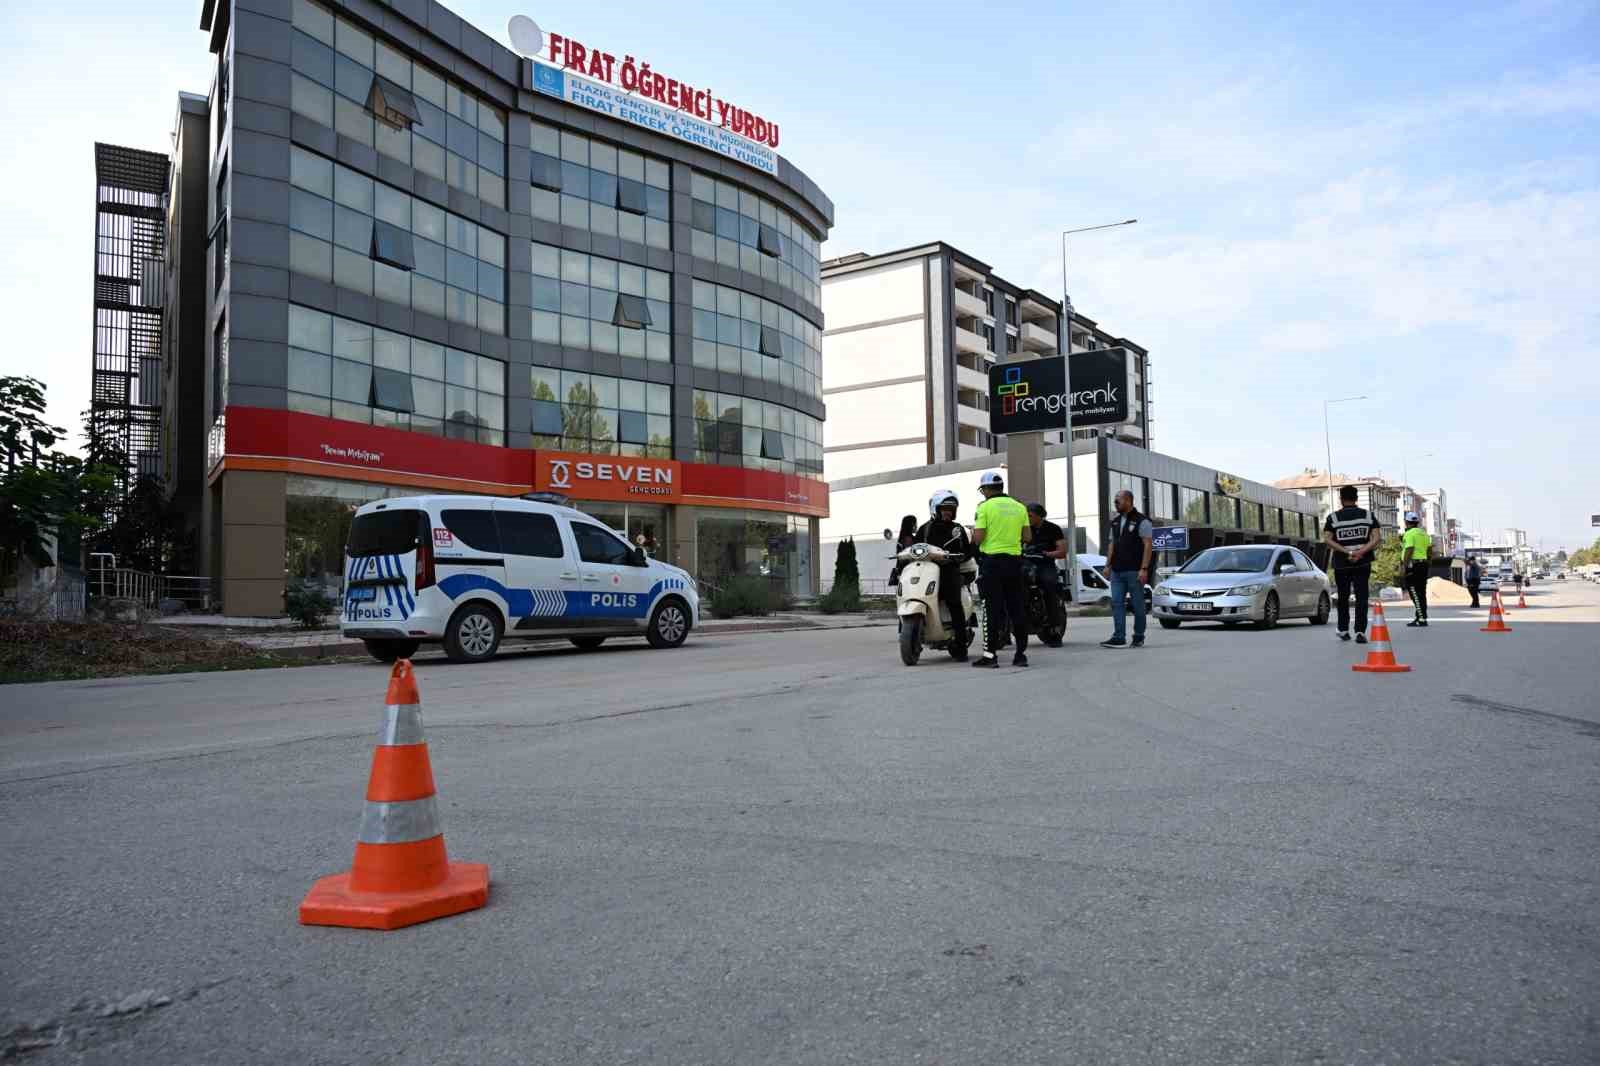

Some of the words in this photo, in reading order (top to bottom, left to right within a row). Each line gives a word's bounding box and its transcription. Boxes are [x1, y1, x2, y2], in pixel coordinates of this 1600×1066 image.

[550, 32, 615, 83] FIRAT
[620, 55, 712, 121] ÖĞRENCİ
[716, 99, 779, 148] YURDU
[664, 111, 677, 122] VE
[571, 91, 613, 113] FIRAT
[620, 107, 668, 131] ERKEK
[735, 147, 774, 172] YURDU
[1015, 381, 1118, 413] rengarenk
[575, 462, 672, 484] SEVEN
[435, 530, 449, 540] 112
